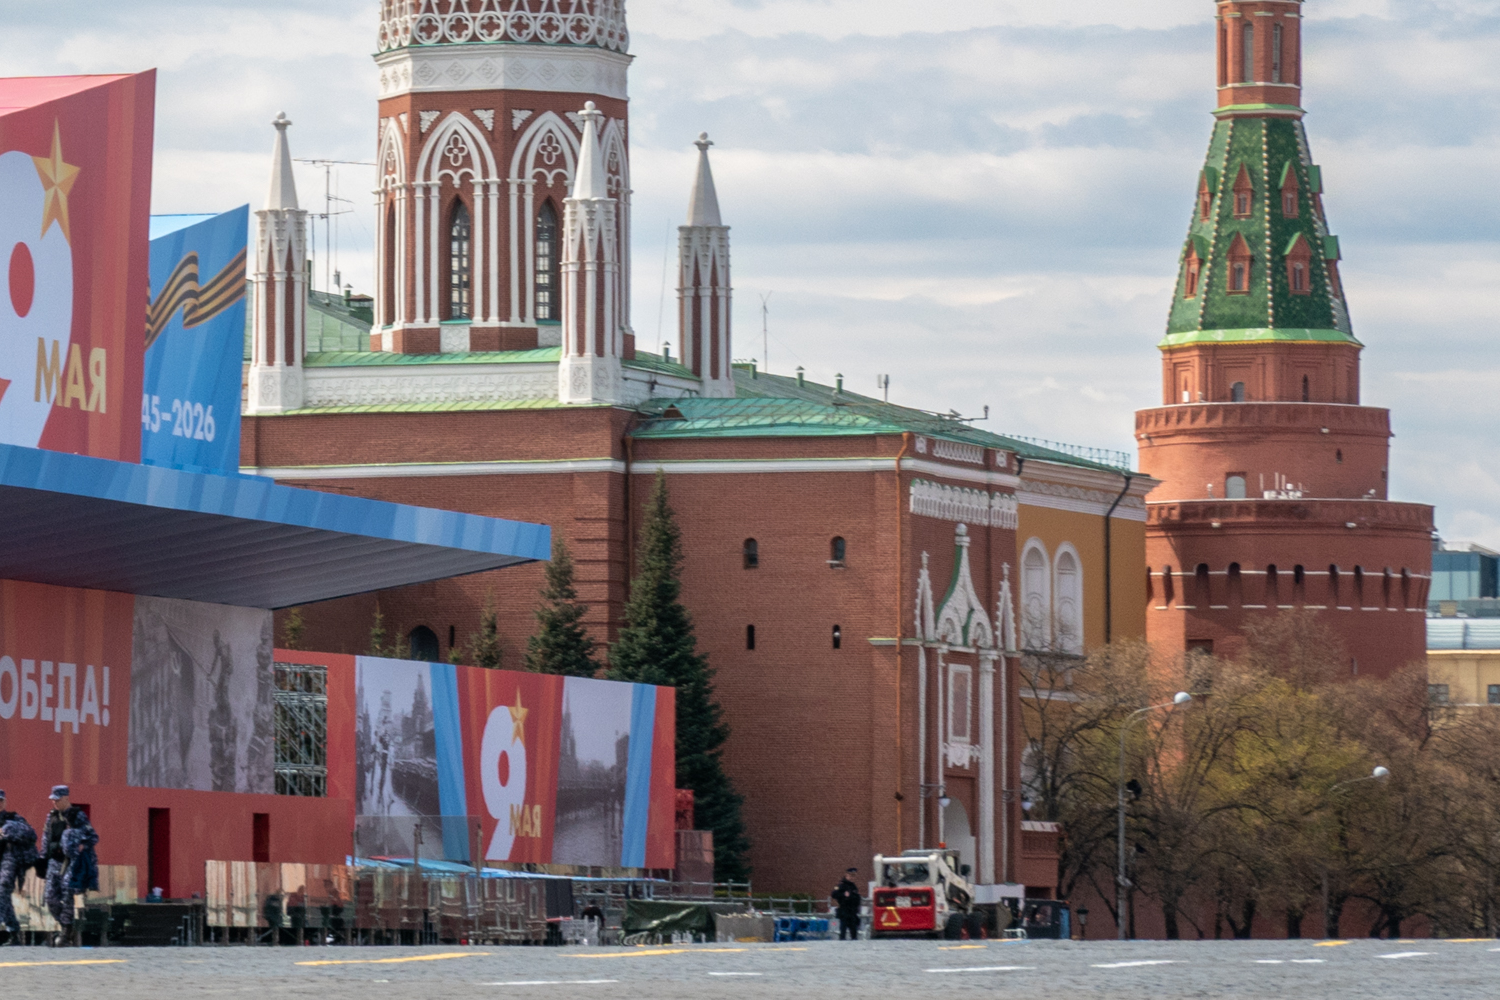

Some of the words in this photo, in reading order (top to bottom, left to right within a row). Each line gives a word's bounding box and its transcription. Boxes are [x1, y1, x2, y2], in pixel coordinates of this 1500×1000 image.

[34, 336, 107, 414] МАЯ
[480, 705, 528, 860] 9
[509, 803, 542, 838] МАЯ
